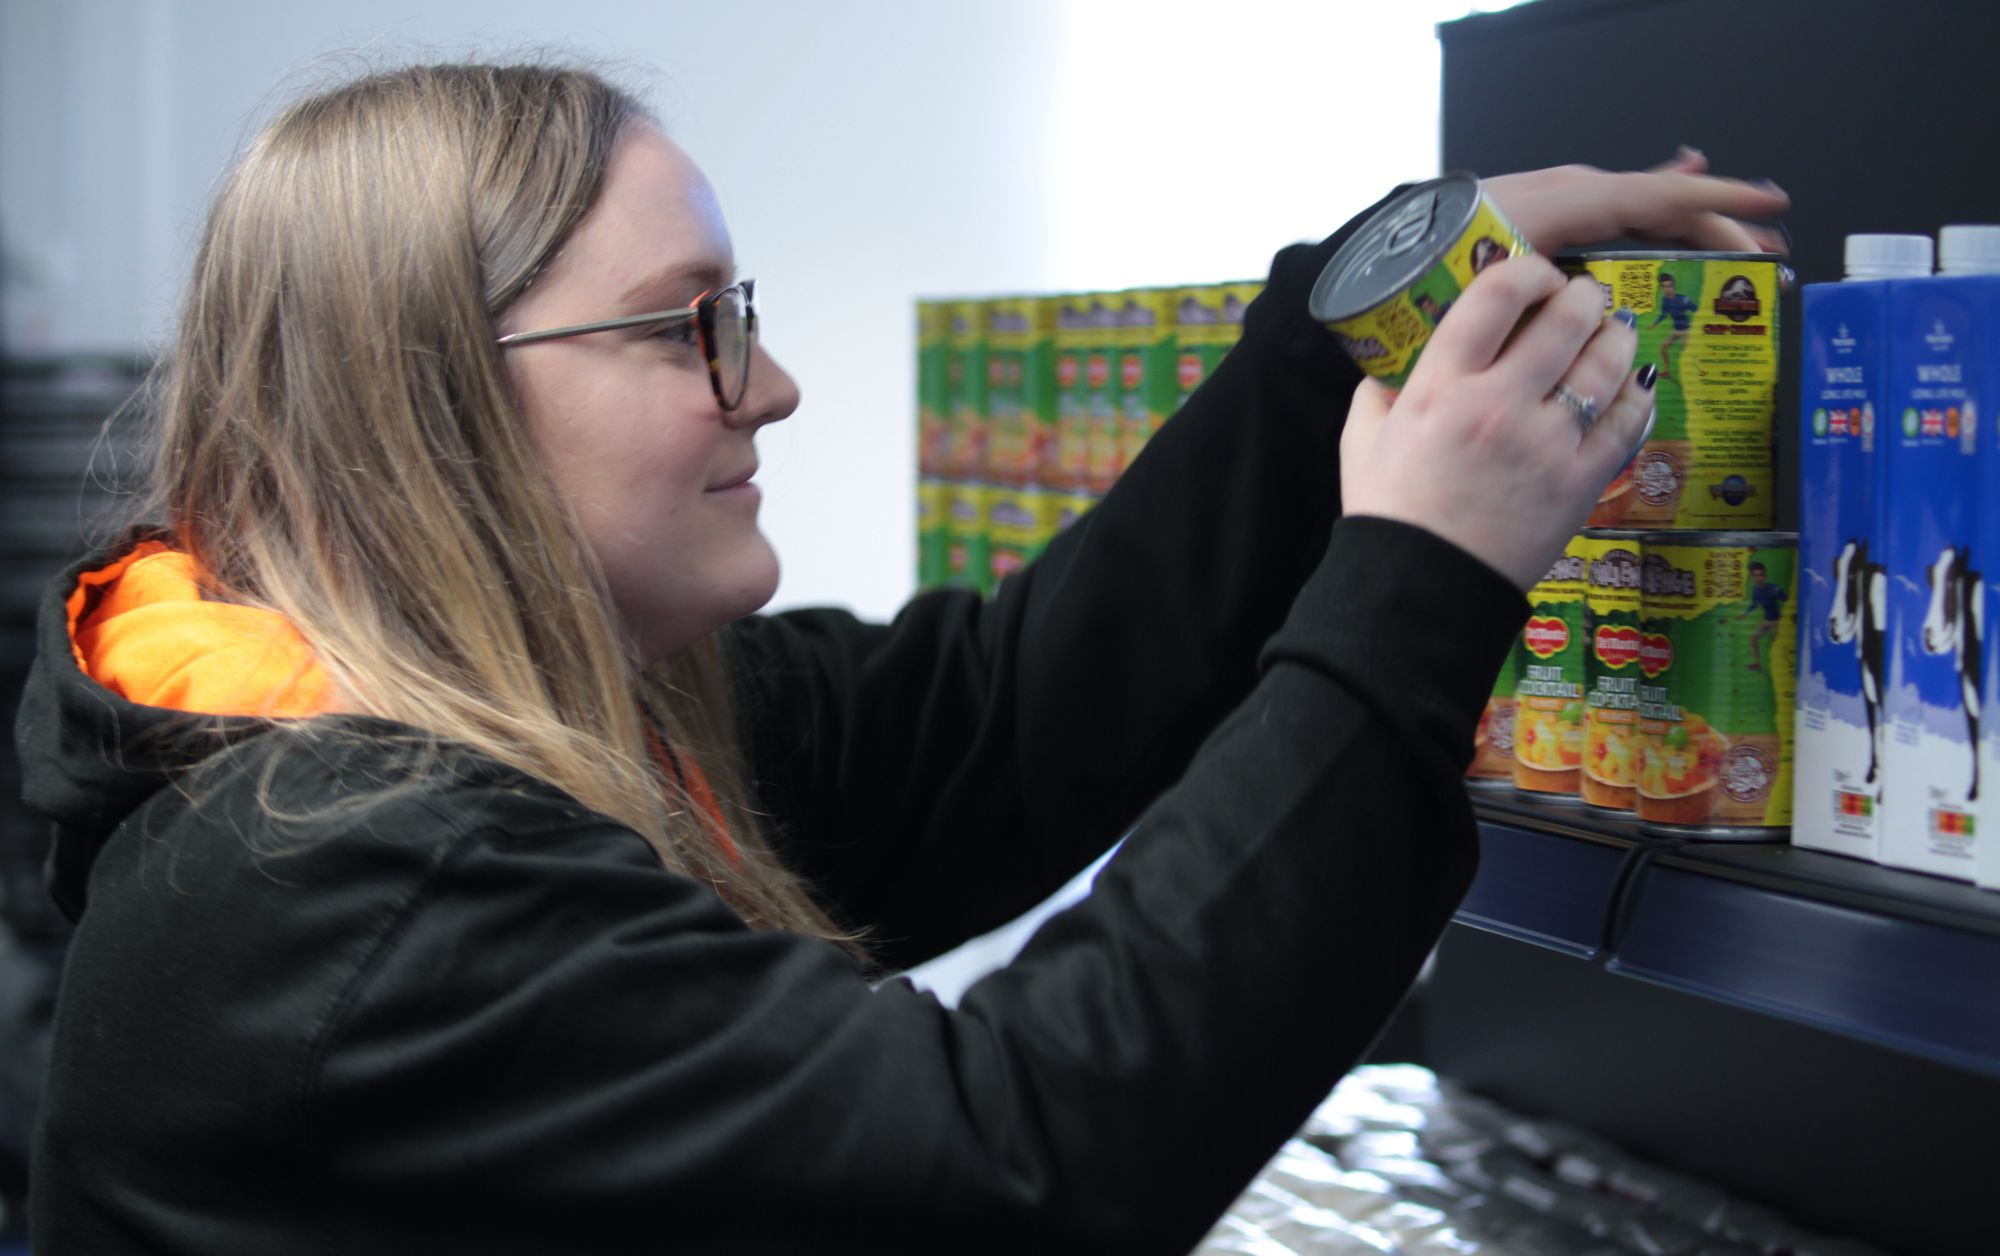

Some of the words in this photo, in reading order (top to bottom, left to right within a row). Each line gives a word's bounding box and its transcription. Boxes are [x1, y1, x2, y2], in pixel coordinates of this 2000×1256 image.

[1527, 664, 1563, 681] FRUIT
[1518, 679, 1580, 699] COCKTAIL
[1597, 675, 1637, 693] FRUIT
